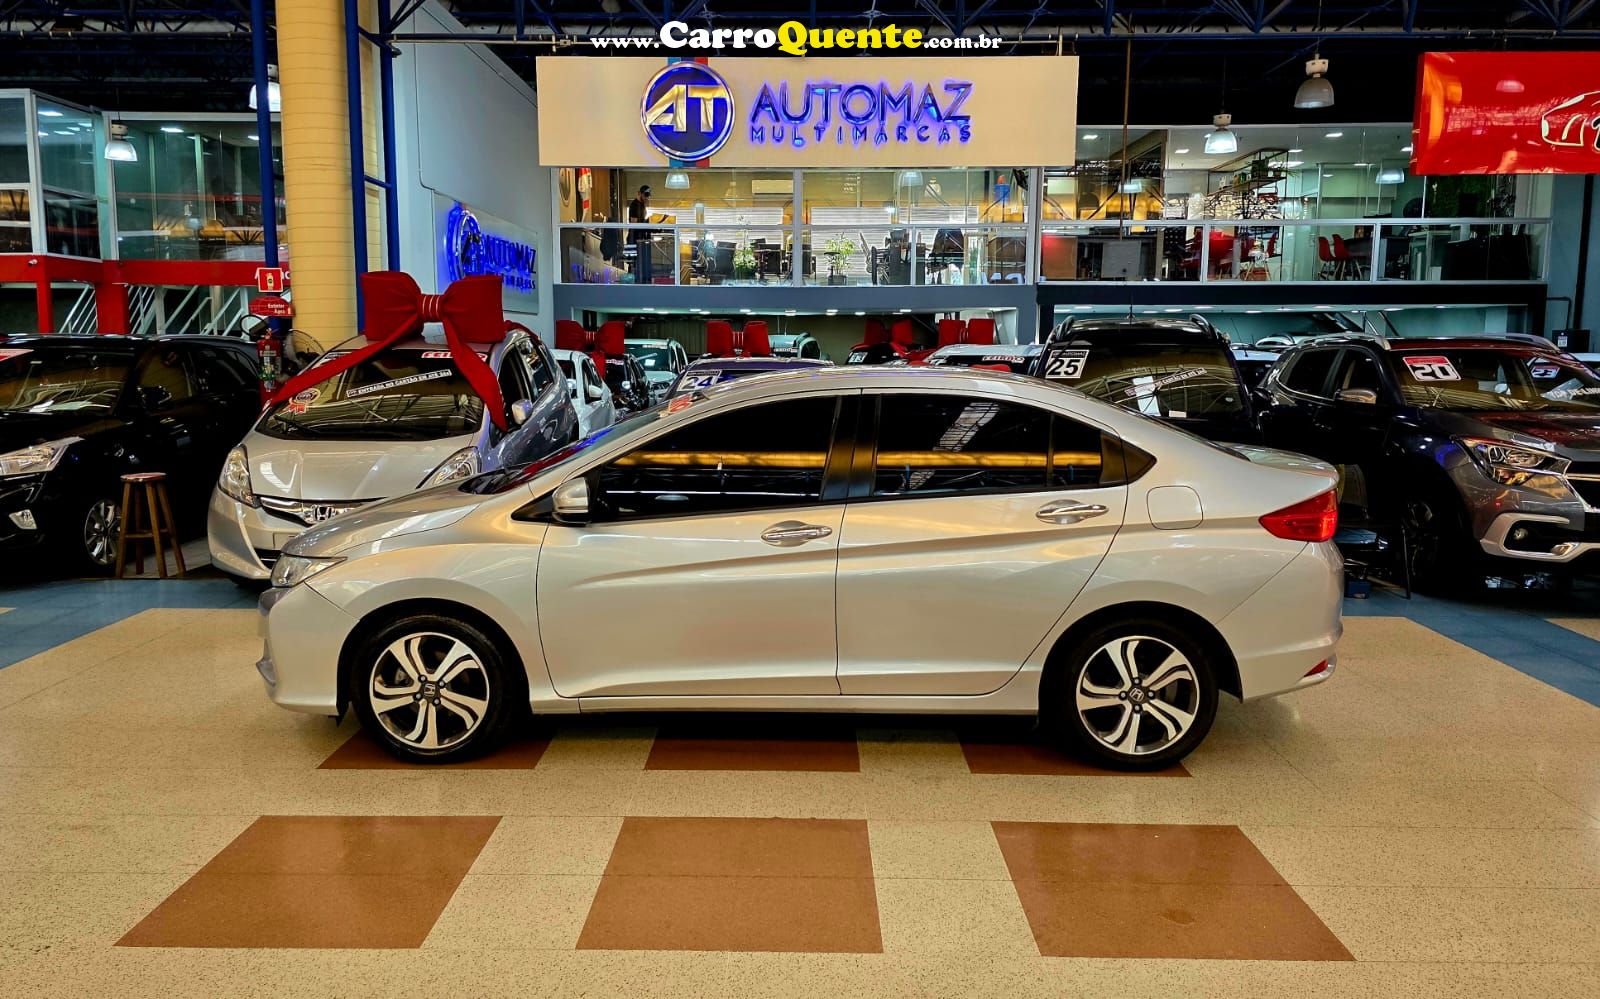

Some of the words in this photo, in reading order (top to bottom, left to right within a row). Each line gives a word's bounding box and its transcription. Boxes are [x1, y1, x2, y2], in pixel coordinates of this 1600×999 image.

[751, 82, 973, 124] AUTOMAZ
[751, 124, 972, 145] MULTIMARCAS
[1047, 359, 1079, 376] 25
[1413, 364, 1458, 380] 20
[681, 376, 714, 389] 24
